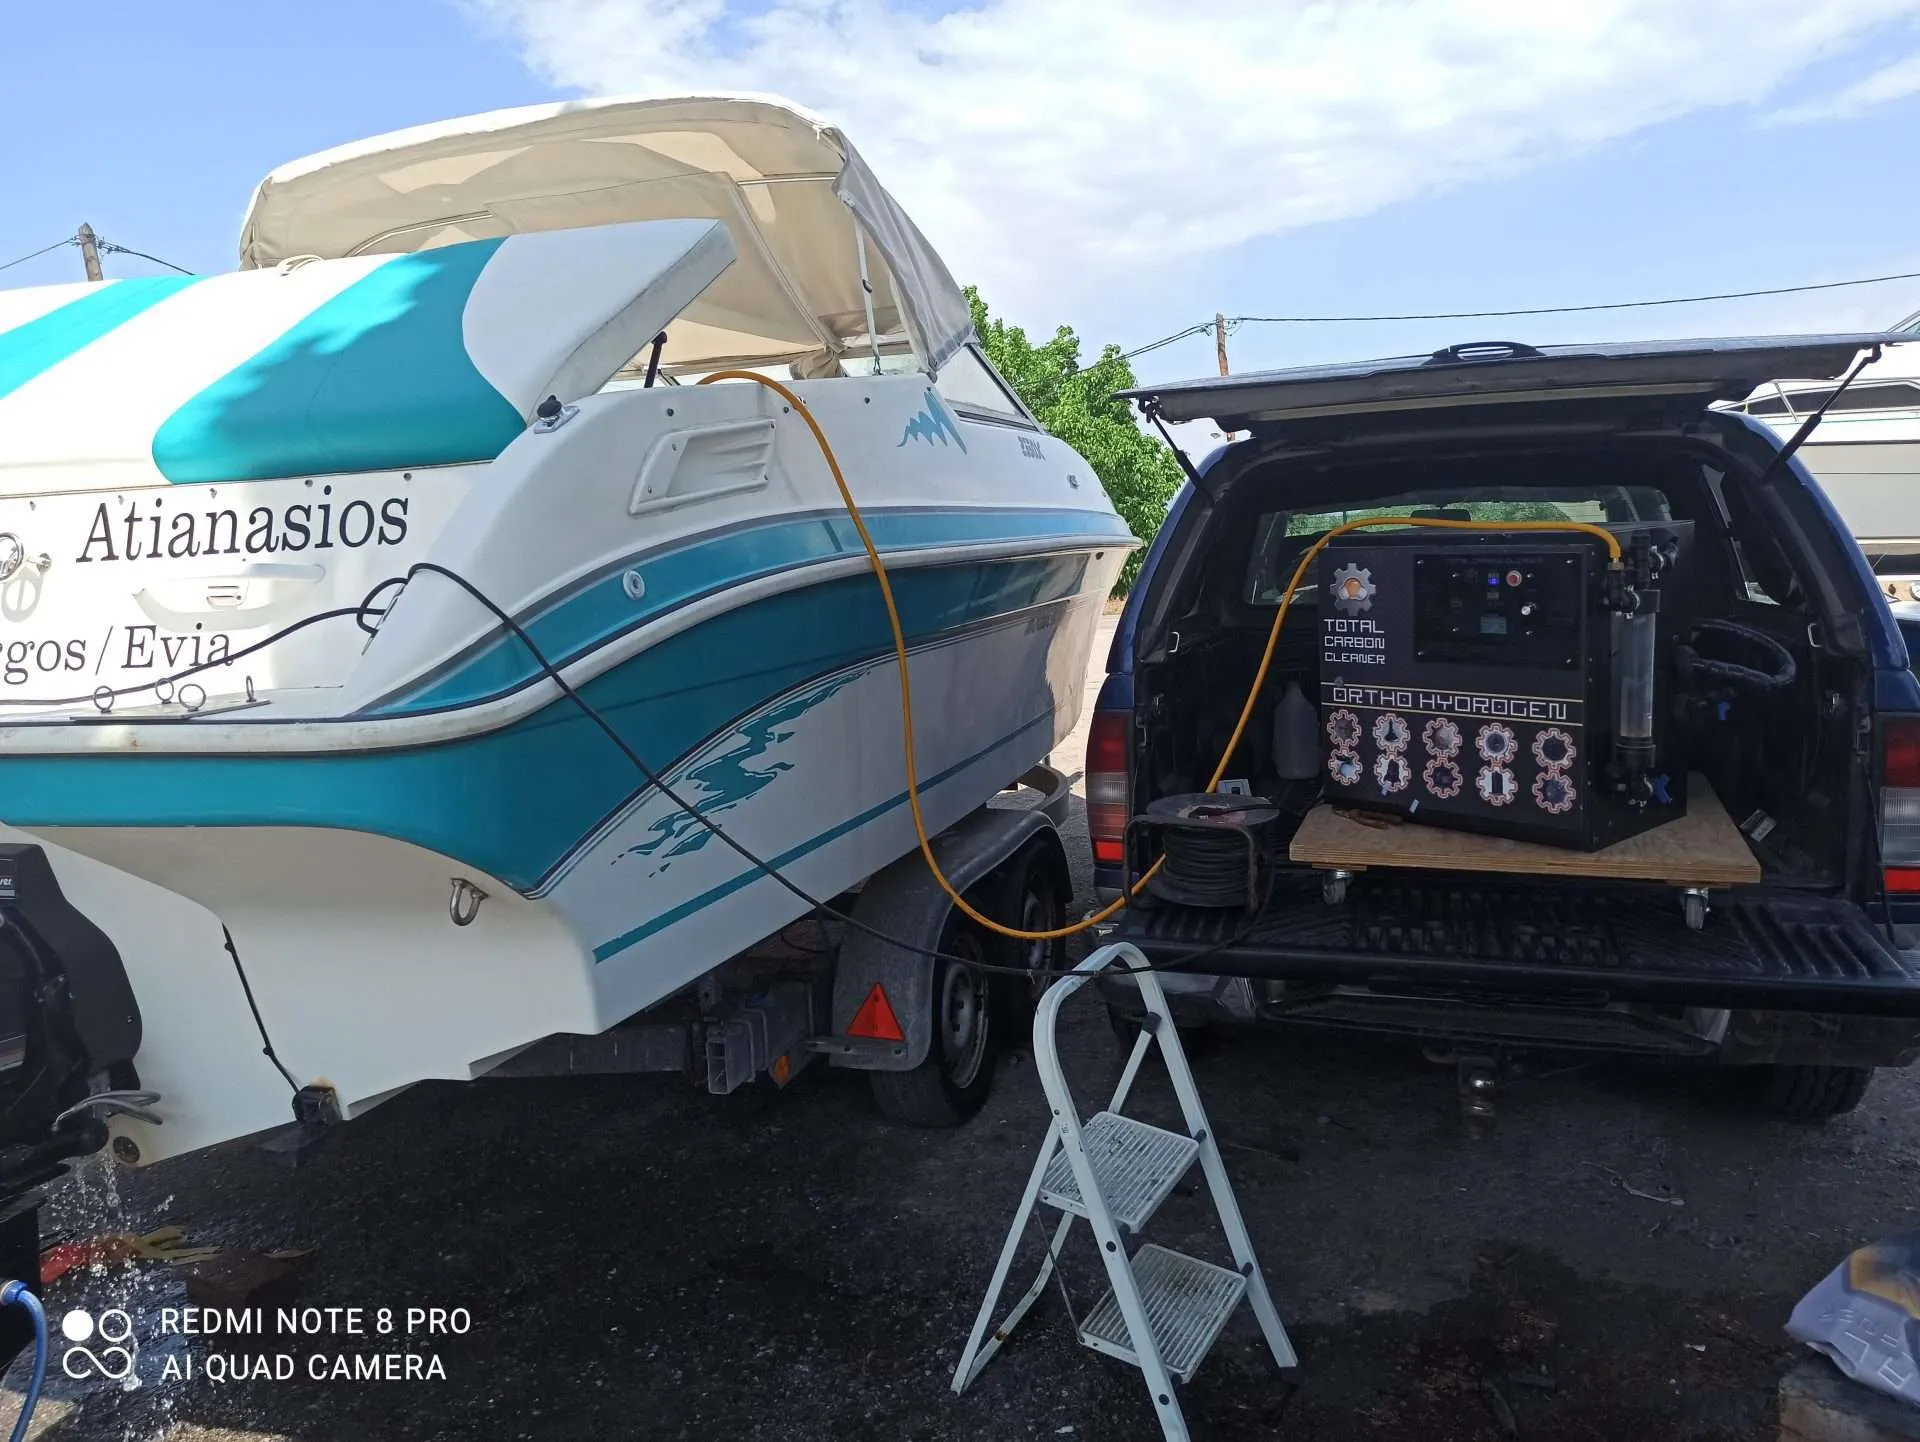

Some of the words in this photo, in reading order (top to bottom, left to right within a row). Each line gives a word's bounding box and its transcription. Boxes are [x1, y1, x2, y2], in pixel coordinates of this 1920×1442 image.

[76, 485, 410, 563] Atianasios
[1323, 618, 1385, 634] TOTAL
[0, 639, 87, 685] gos
[121, 622, 234, 669] Evia
[1324, 635, 1385, 649] CARBON
[1324, 652, 1386, 665] CLEANER
[1333, 687, 1412, 708] ORTHO
[1420, 693, 1567, 720] HYDROGEN
